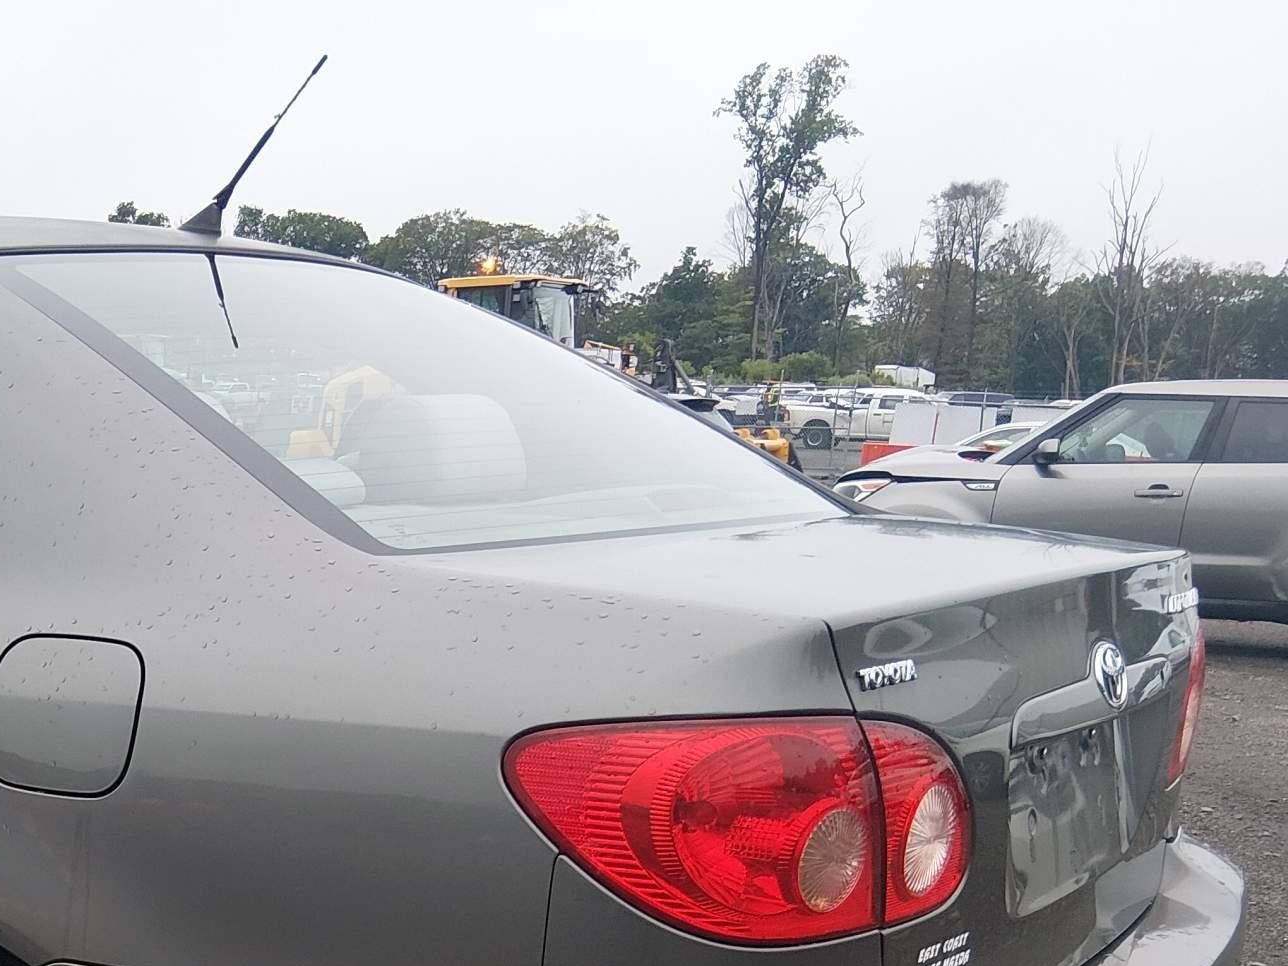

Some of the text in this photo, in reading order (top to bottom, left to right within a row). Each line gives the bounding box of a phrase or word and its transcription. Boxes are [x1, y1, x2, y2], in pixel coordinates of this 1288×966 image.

[859, 659, 918, 690] TOYOTA
[918, 931, 970, 963] EAST COAST
